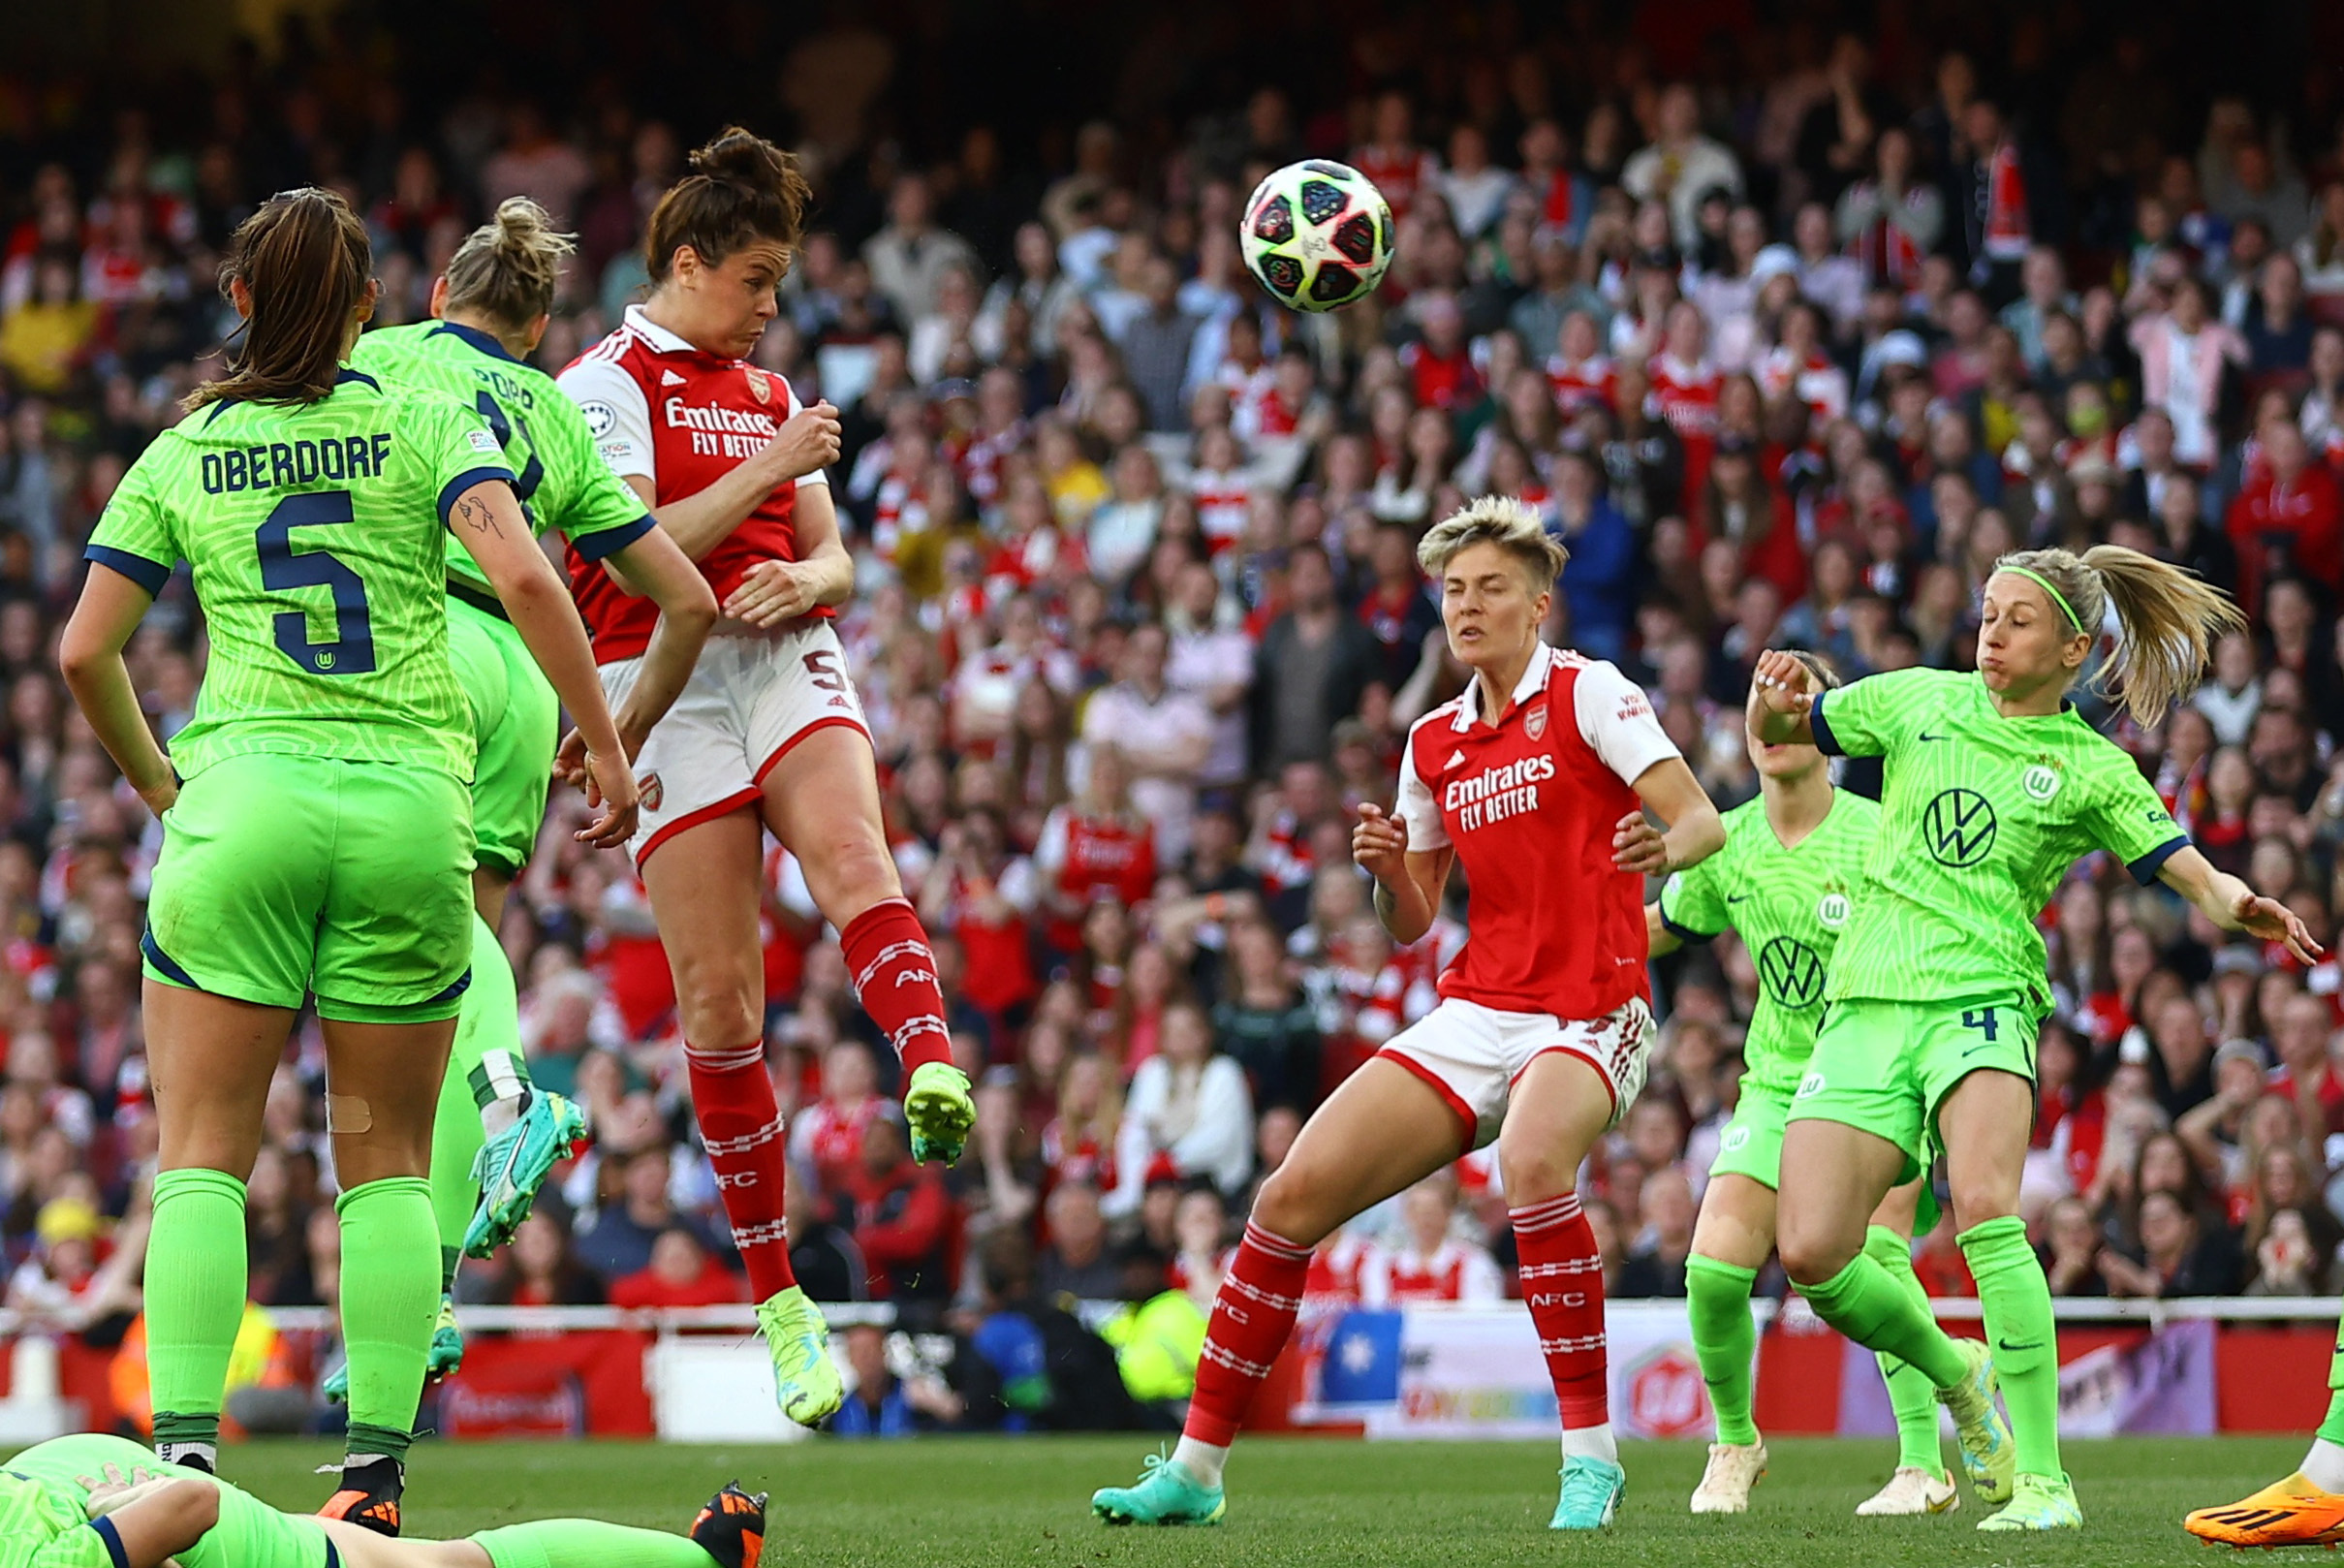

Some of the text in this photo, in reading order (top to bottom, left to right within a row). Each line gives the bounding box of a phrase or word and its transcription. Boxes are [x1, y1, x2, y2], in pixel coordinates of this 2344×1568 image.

[665, 396, 778, 437] Emirates
[202, 433, 391, 495] OBERDORF
[692, 431, 719, 456] FLY
[255, 489, 377, 676] 5
[801, 649, 847, 692] 5
[1445, 753, 1556, 813] Emirates
[1459, 784, 1539, 834] FLY BETTER
[1961, 1007, 1999, 1042] 4
[1531, 1292, 1586, 1307] AFC
